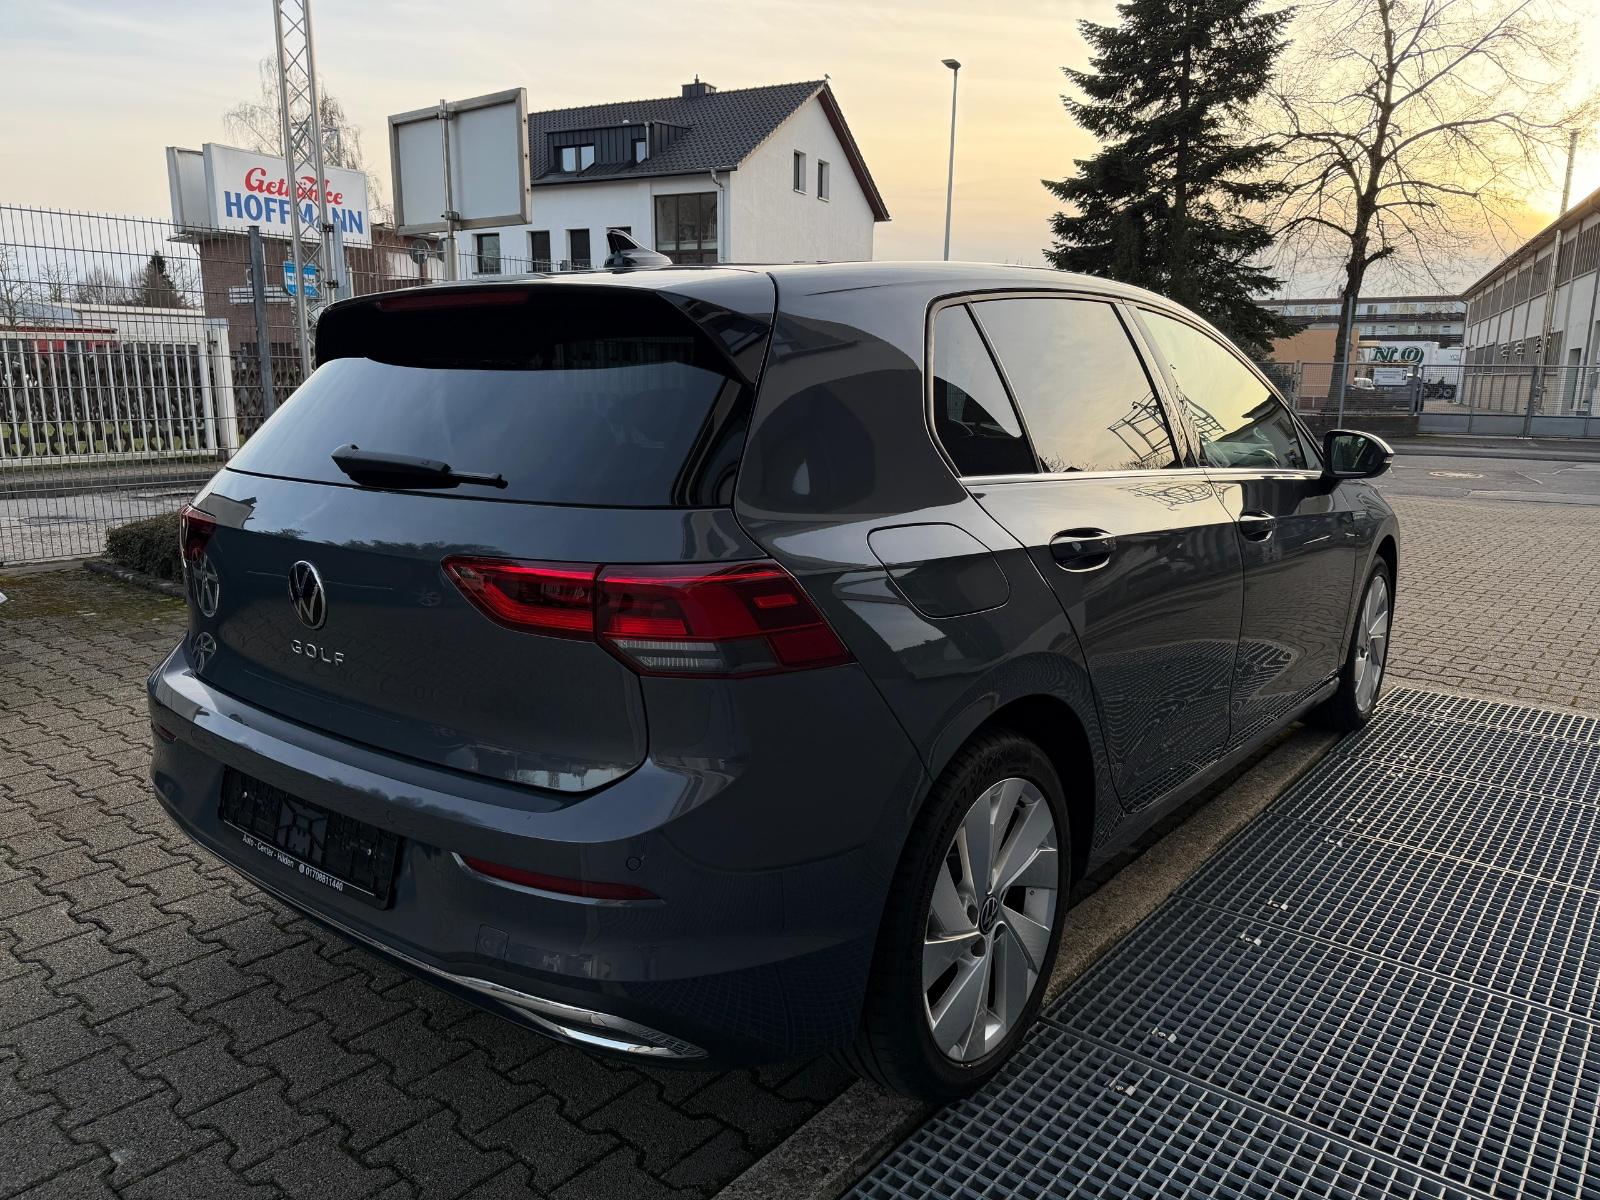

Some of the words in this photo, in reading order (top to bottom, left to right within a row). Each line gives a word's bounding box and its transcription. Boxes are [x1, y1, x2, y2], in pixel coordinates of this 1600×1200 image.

[224, 190, 364, 235] HOFFMNN
[291, 639, 345, 667] GOLF
[257, 841, 274, 857] Center
